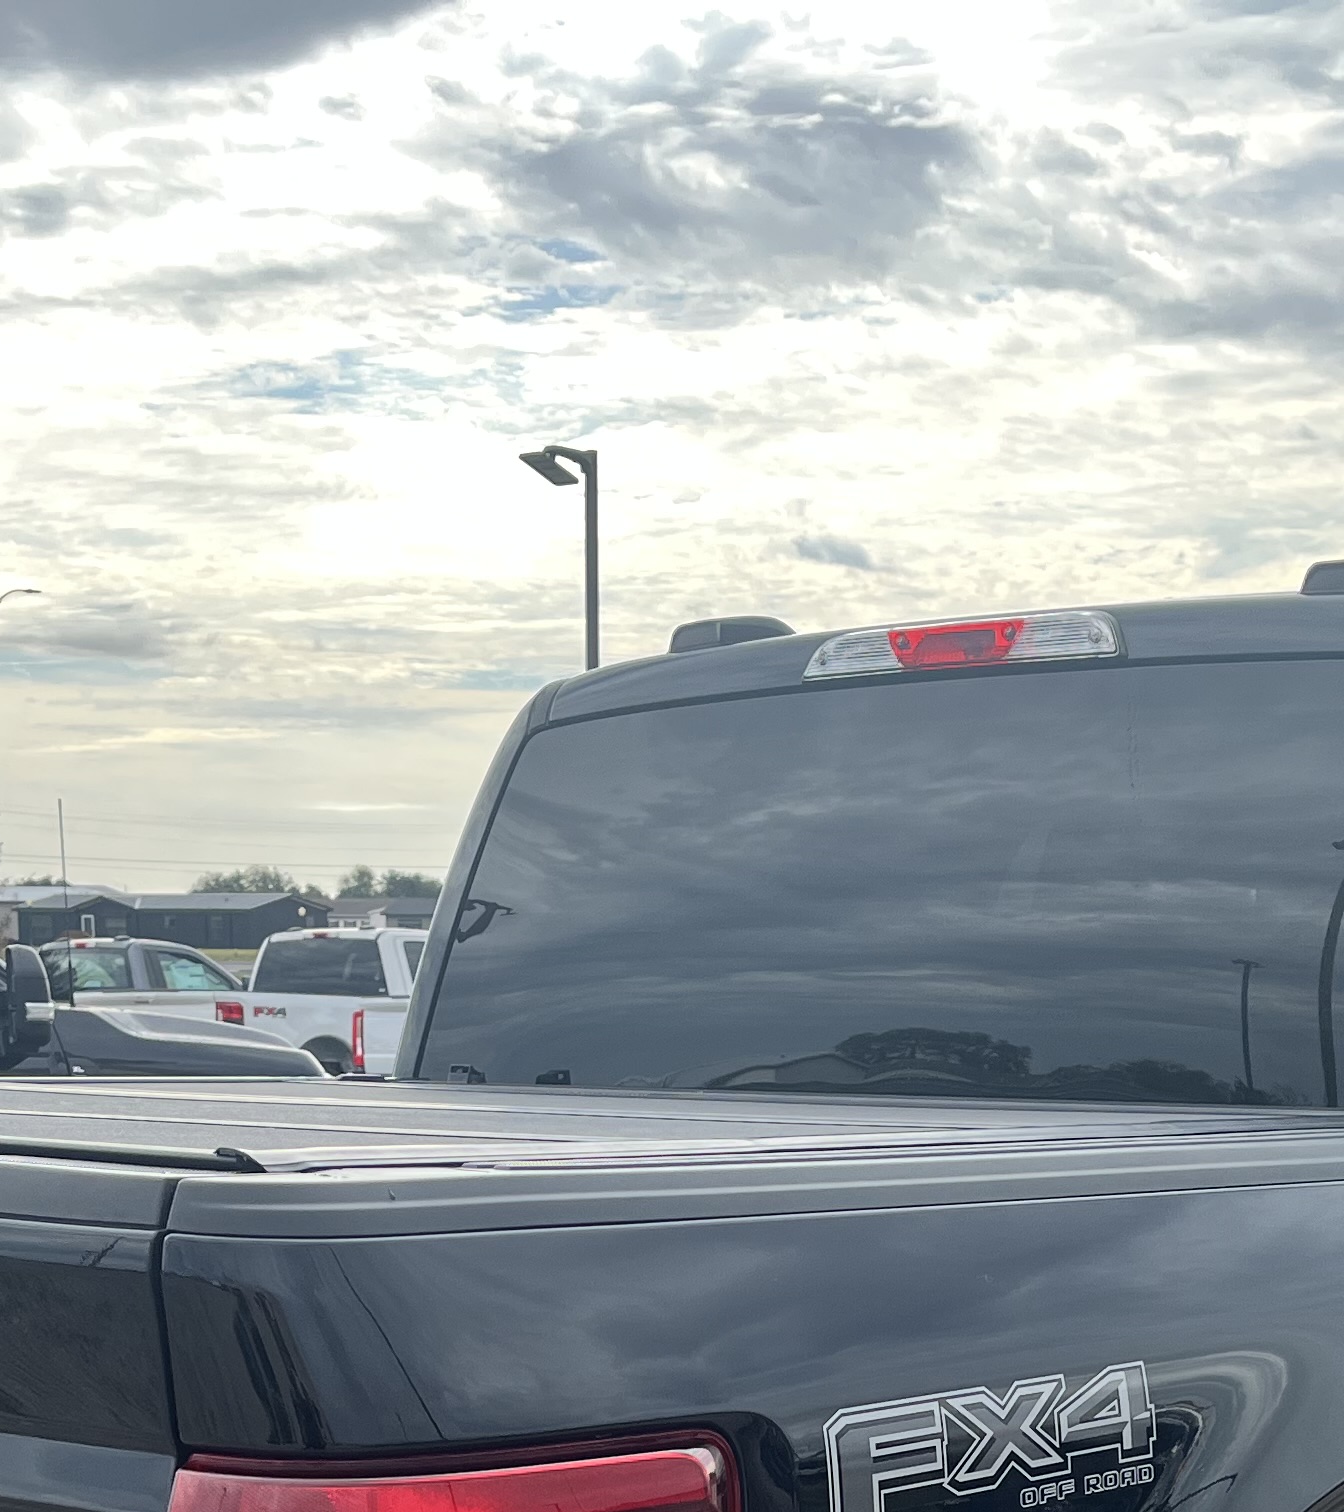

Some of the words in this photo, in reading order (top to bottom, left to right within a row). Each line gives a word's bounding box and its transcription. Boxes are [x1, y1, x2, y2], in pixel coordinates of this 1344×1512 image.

[254, 1006, 287, 1018] FX4
[1019, 1478, 1076, 1508] OFF
[1083, 1463, 1155, 1495] ROAD
